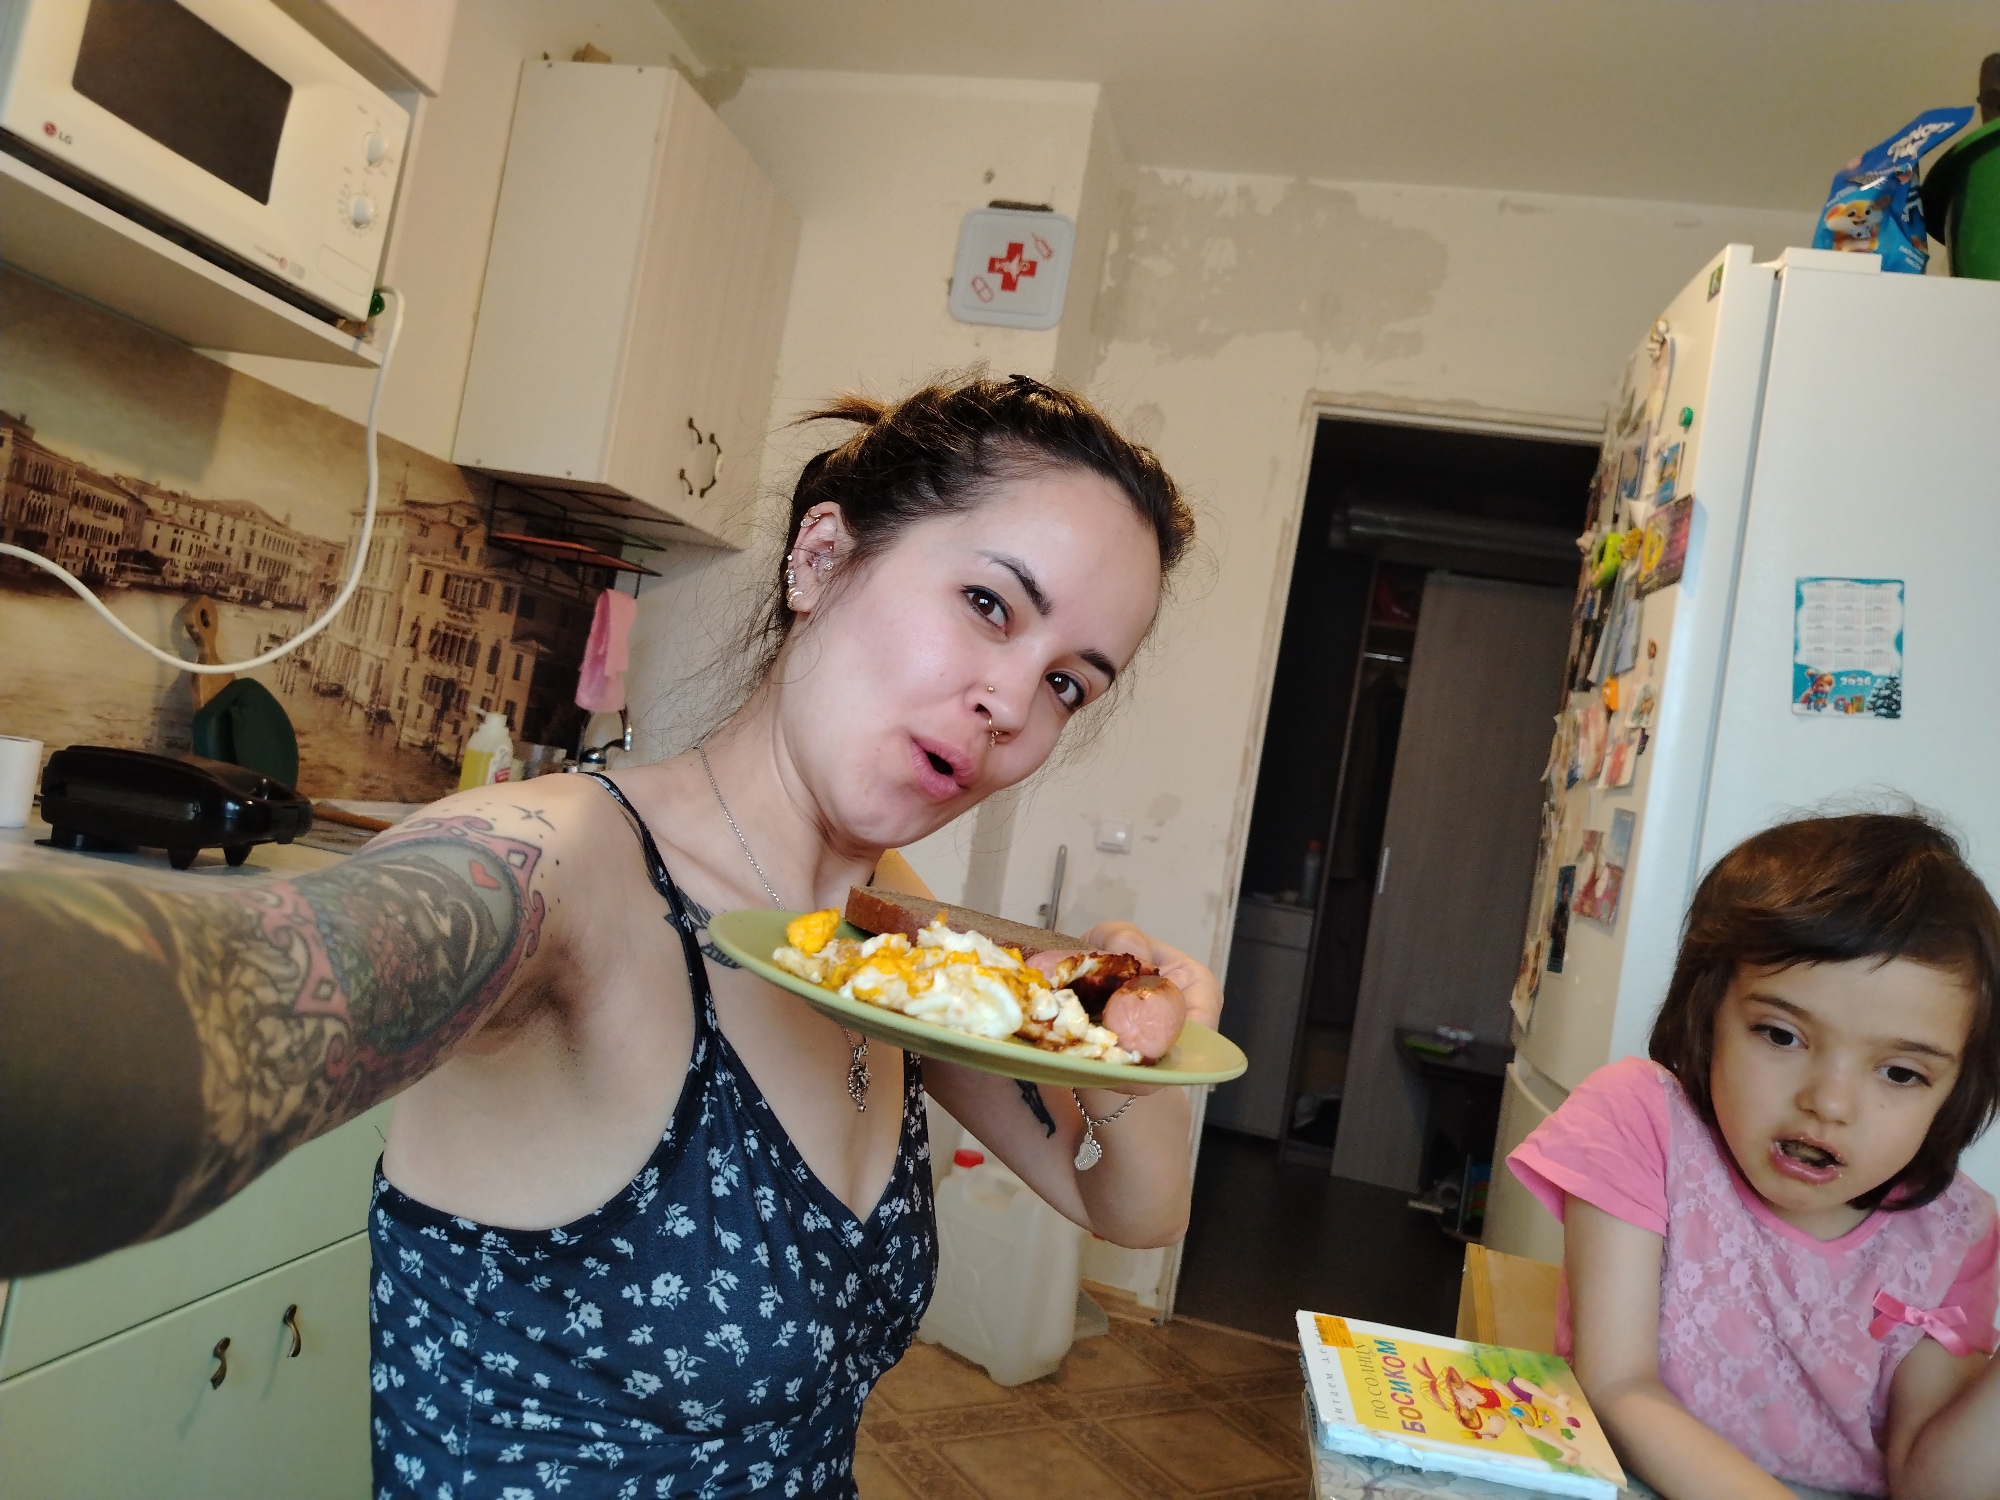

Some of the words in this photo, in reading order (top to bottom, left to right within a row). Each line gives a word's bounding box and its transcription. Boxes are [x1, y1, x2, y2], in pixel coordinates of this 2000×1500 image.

[59, 131, 72, 145] LG
[1355, 1341, 1382, 1396] СОЛНЦУ
[1373, 1339, 1426, 1434] БОСИКОМ
[1371, 1399, 1389, 1419] ПО
